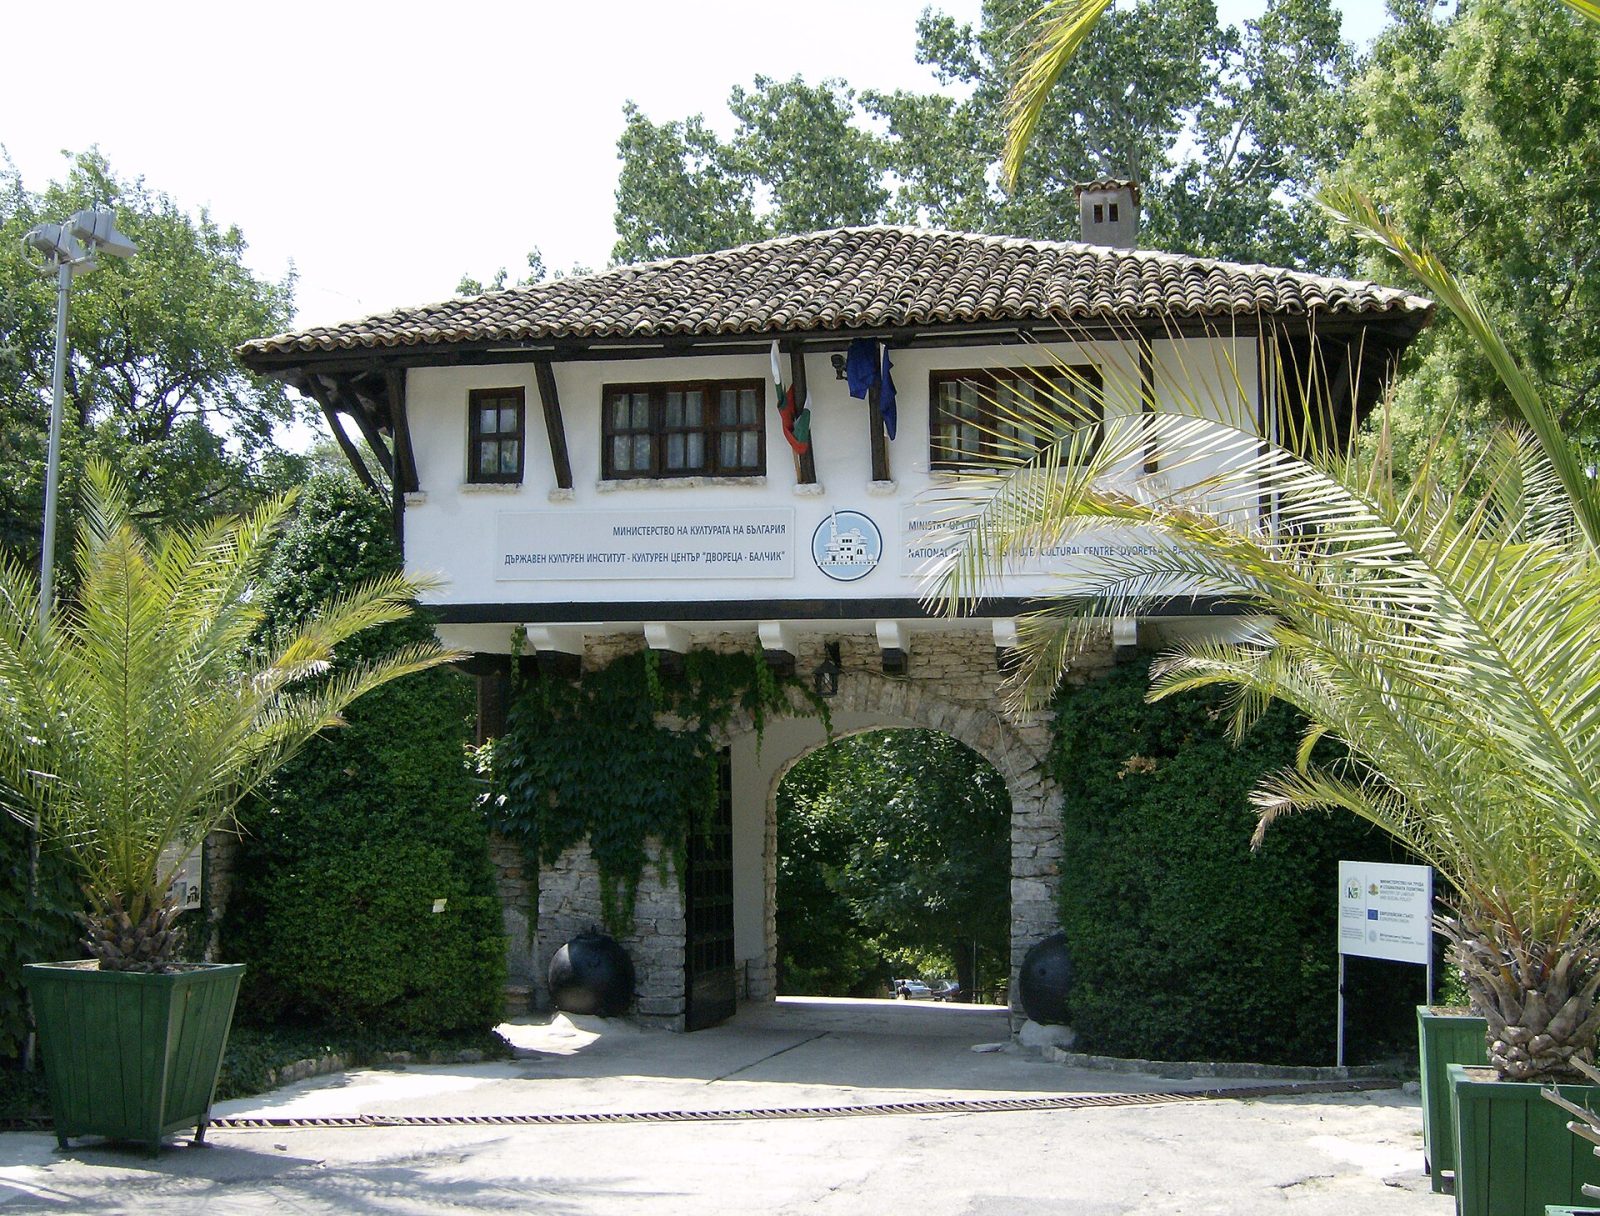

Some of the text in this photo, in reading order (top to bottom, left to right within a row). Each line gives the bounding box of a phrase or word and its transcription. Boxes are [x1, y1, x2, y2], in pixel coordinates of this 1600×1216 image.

[612, 524, 786, 536] МИНИСТЕРСТВО НА КУЛТУРАТА НА БЪЛГАРИЯ
[504, 554, 547, 565] ДЪРЖАВЕН
[548, 553, 584, 563] КУЛТУРЕН
[587, 552, 626, 563] ИНСТИТУТ
[632, 552, 669, 563] КУЛТУРЕН
[671, 552, 701, 564] ЦЕНТЪР
